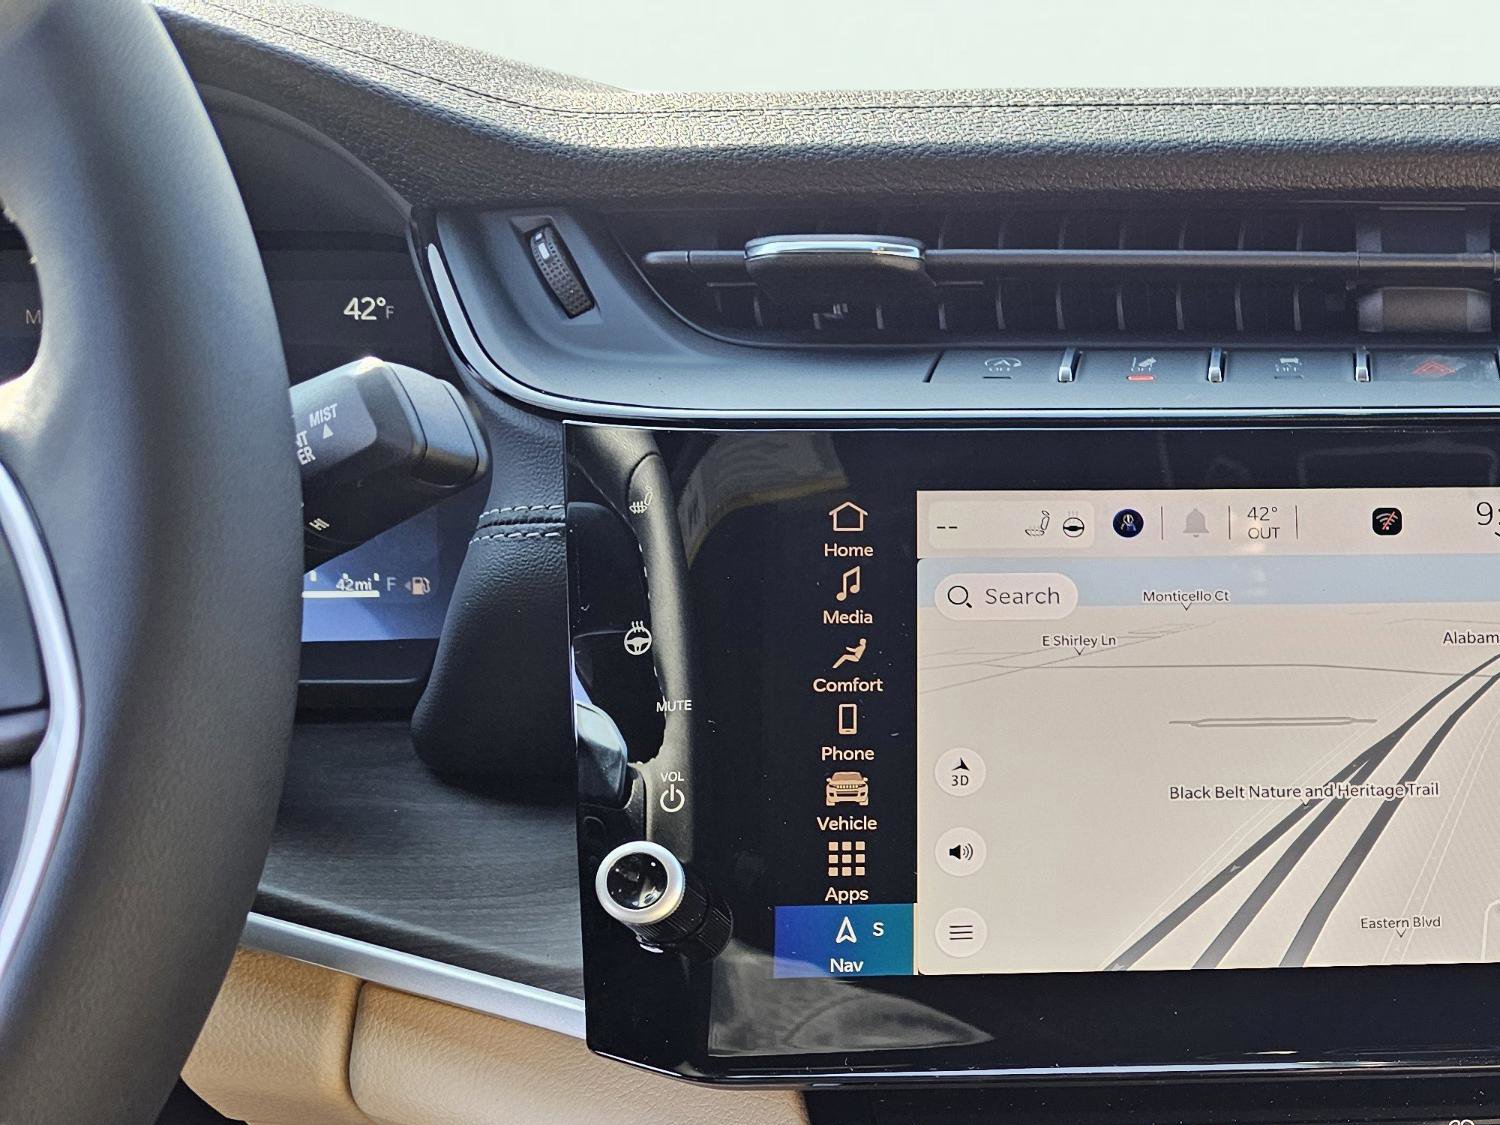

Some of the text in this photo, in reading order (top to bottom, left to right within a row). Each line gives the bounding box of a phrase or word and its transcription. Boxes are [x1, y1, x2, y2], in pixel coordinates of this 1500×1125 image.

[309, 403, 338, 427] MIST
[1247, 506, 1278, 521] 42°
[1248, 527, 1280, 540] OUT
[824, 543, 874, 557] Home
[985, 587, 1060, 605] Search
[1143, 590, 1229, 602] Monticello Ct
[823, 610, 873, 624] Media
[1042, 634, 1116, 649] E Shirley Ln
[812, 678, 884, 692] Comfort
[656, 700, 692, 711] MUTE
[821, 746, 875, 761] Phone
[660, 771, 684, 782] VOL
[951, 775, 969, 786] 3D
[1170, 783, 1439, 800] Black Belt Nature and Heritage Trail
[817, 816, 877, 831] Vehicle
[824, 887, 869, 904] Apps
[872, 922, 885, 936] S
[1360, 916, 1441, 928] Eastern Blvd
[830, 958, 864, 973] Nav
